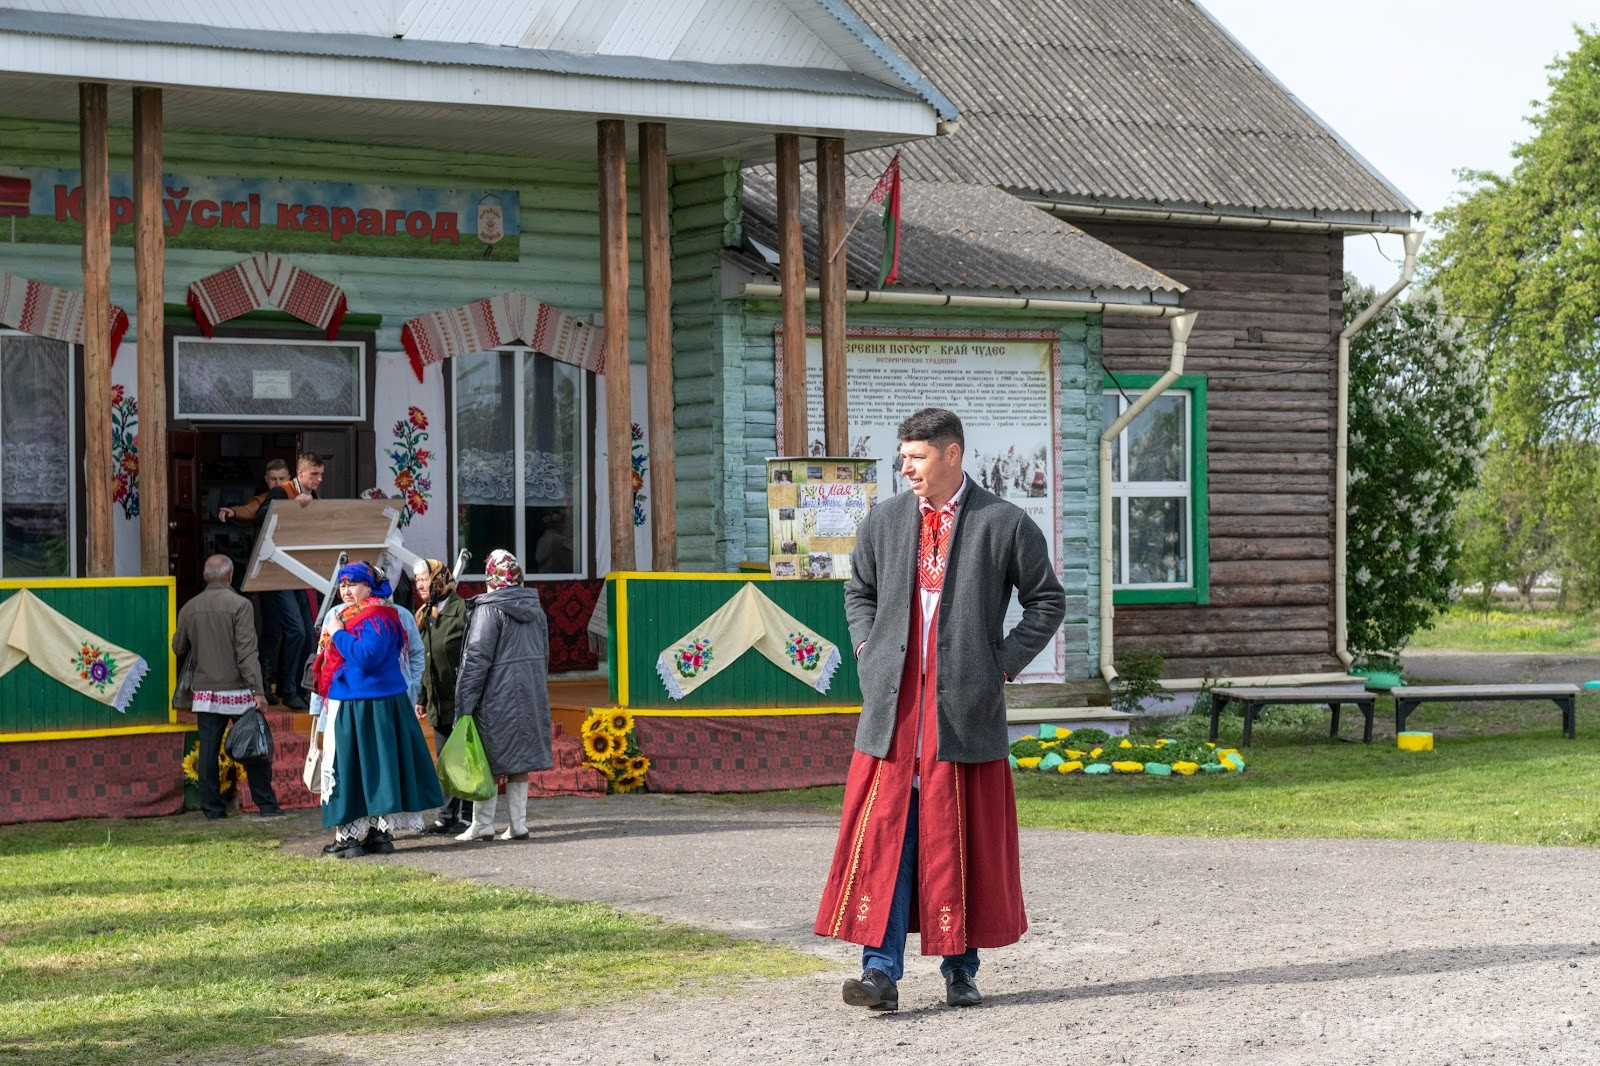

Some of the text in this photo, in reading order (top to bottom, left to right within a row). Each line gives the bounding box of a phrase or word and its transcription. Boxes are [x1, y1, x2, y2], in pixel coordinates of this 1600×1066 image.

[277, 203, 460, 245] карагод
[846, 343, 886, 353] ЕРЕВНЯ
[890, 344, 930, 355] ПОГОСТ
[940, 343, 968, 355] КРАЙ
[972, 345, 1006, 357] ЧУДЕС
[925, 357, 957, 365] ТРАДИЦИИ
[818, 484, 825, 496] 6
